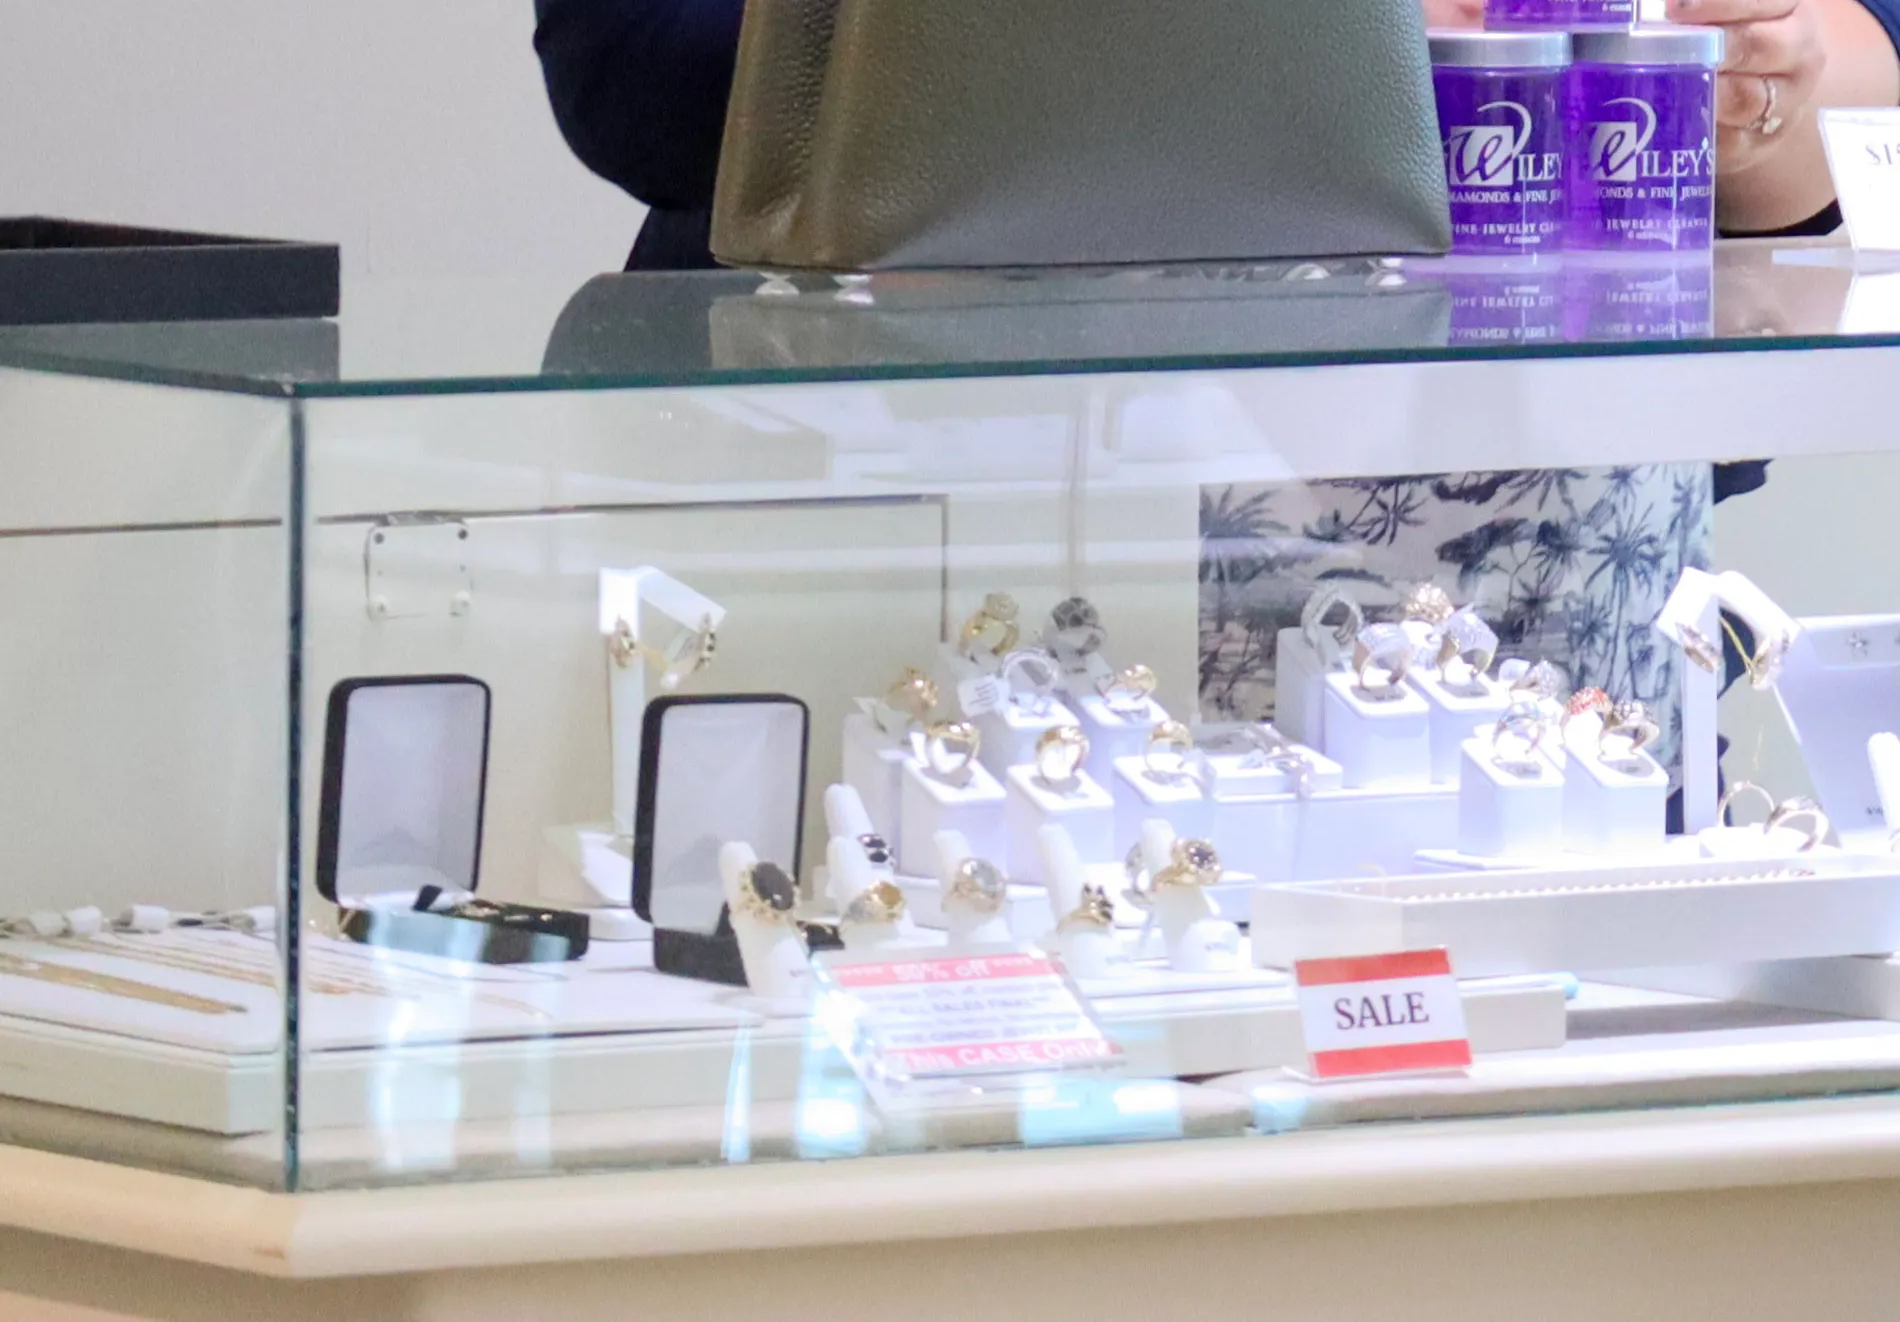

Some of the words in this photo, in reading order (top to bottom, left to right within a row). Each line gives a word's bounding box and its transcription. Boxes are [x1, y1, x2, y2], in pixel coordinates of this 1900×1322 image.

[1482, 223, 1537, 235] JEWELRY
[1333, 991, 1430, 1031] SALE
[958, 1044, 1036, 1068] CASE
[1041, 1038, 1113, 1062] Only
